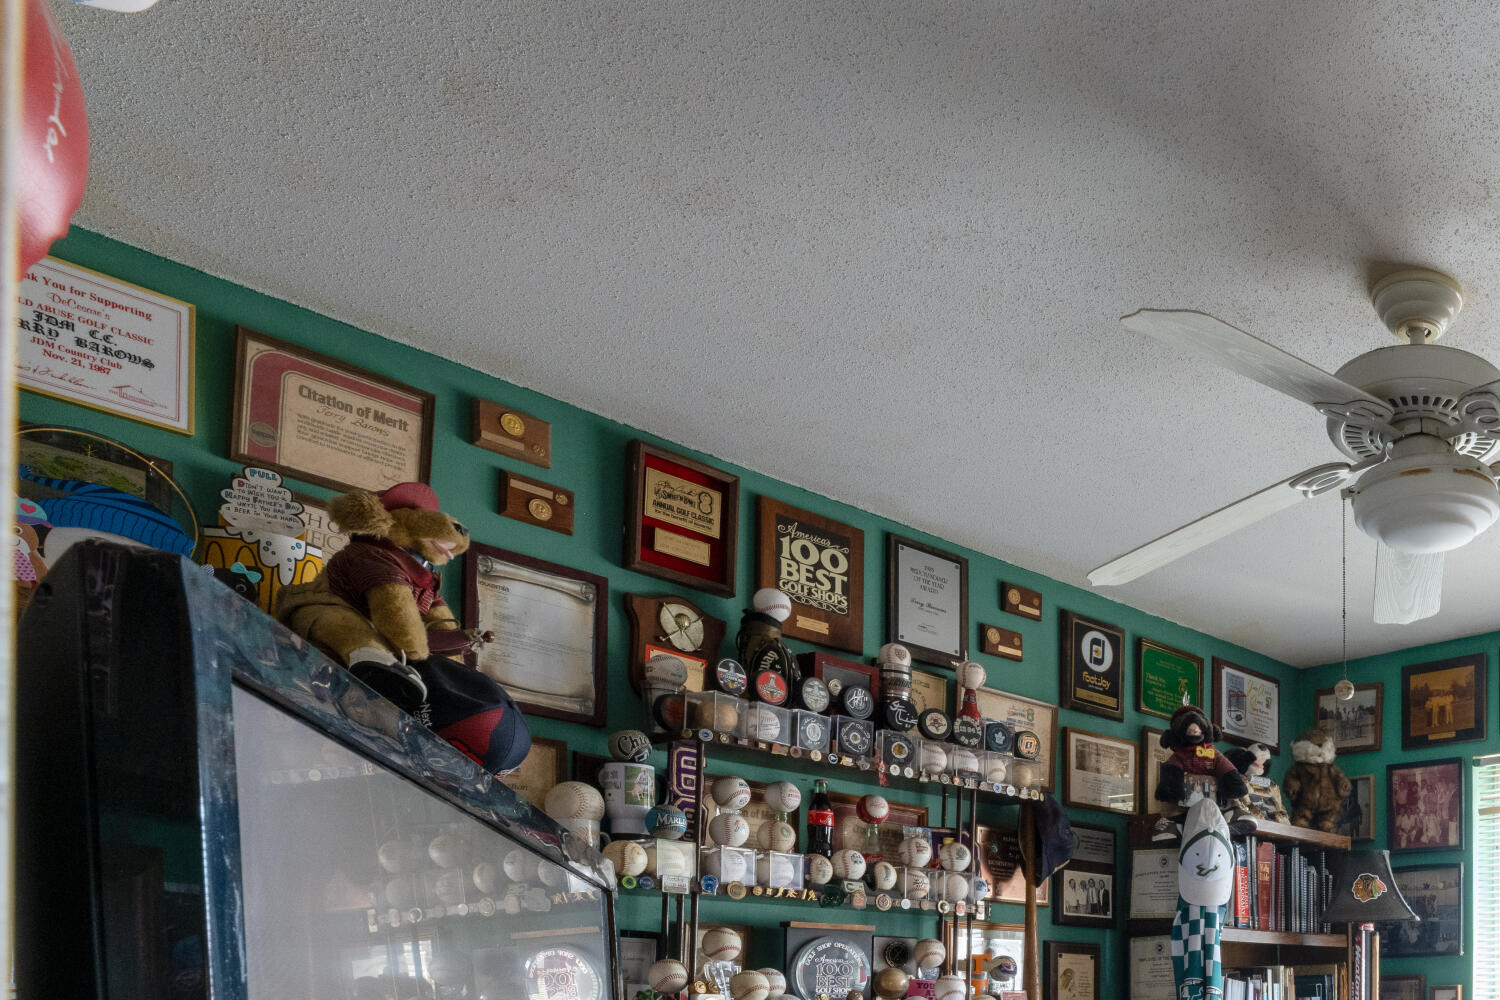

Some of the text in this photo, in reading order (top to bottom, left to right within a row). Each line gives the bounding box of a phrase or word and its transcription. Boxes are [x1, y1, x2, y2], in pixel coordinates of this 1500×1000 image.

[42, 276, 66, 291] You
[70, 285, 86, 297] for
[90, 292, 152, 322] Supporting
[33, 310, 75, 332] JDM
[37, 303, 154, 346] ABUSE GOLF CLASSIC
[18, 318, 155, 371] RRY BAROWS
[30, 336, 123, 370] JDM Country Club
[42, 349, 68, 363] Nov.
[89, 362, 112, 376] 1987
[298, 384, 409, 432] Citation of Merit
[249, 469, 277, 481] PULL
[224, 491, 250, 503] HAPPY
[252, 497, 283, 508] FATHER'S
[247, 490, 265, 498] WISH
[266, 487, 288, 496] WANT
[234, 506, 251, 515] BEER
[236, 501, 257, 510] UNTIL
[652, 499, 714, 525] ANNUAL GOLF CLASSIC
[780, 535, 849, 575] 100
[780, 557, 848, 595] BEST
[779, 580, 848, 609] GOLF SHOPS
[419, 703, 433, 728] Next
[656, 813, 687, 828] MARLI
[804, 949, 816, 966] GOLF
[816, 942, 832, 952] SHOP
[816, 963, 853, 977] 100
[816, 976, 852, 988] BEST
